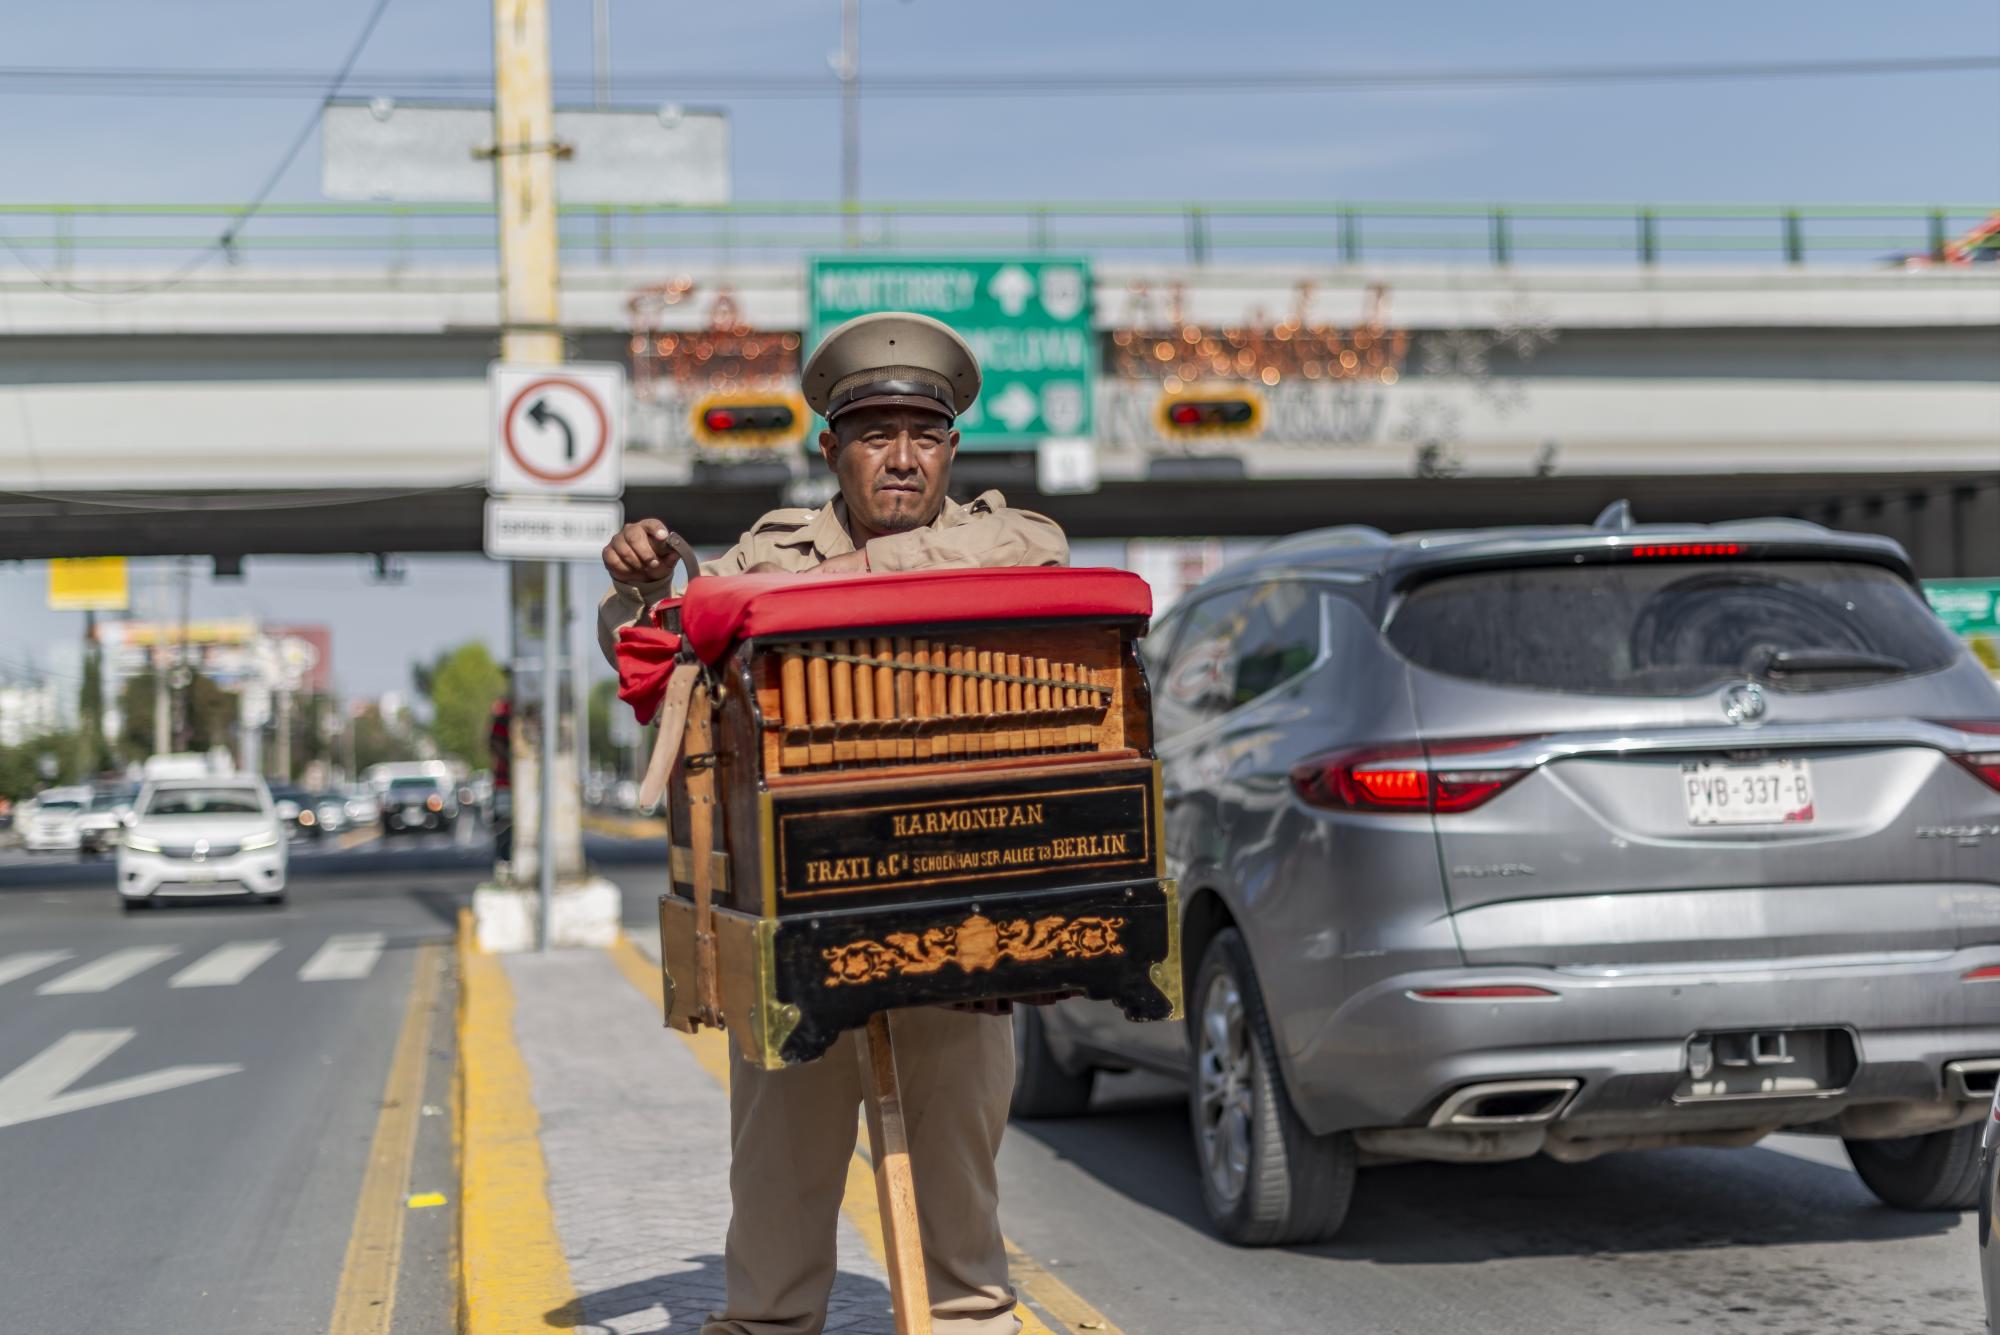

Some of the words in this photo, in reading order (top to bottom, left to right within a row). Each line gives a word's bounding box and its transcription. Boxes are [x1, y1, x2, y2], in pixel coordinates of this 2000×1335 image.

[1687, 775, 1808, 807] PVB-337-B
[892, 804, 1043, 837] HARMONIPAN
[806, 856, 871, 883] FRATI
[1002, 846, 1035, 865] ALLEE
